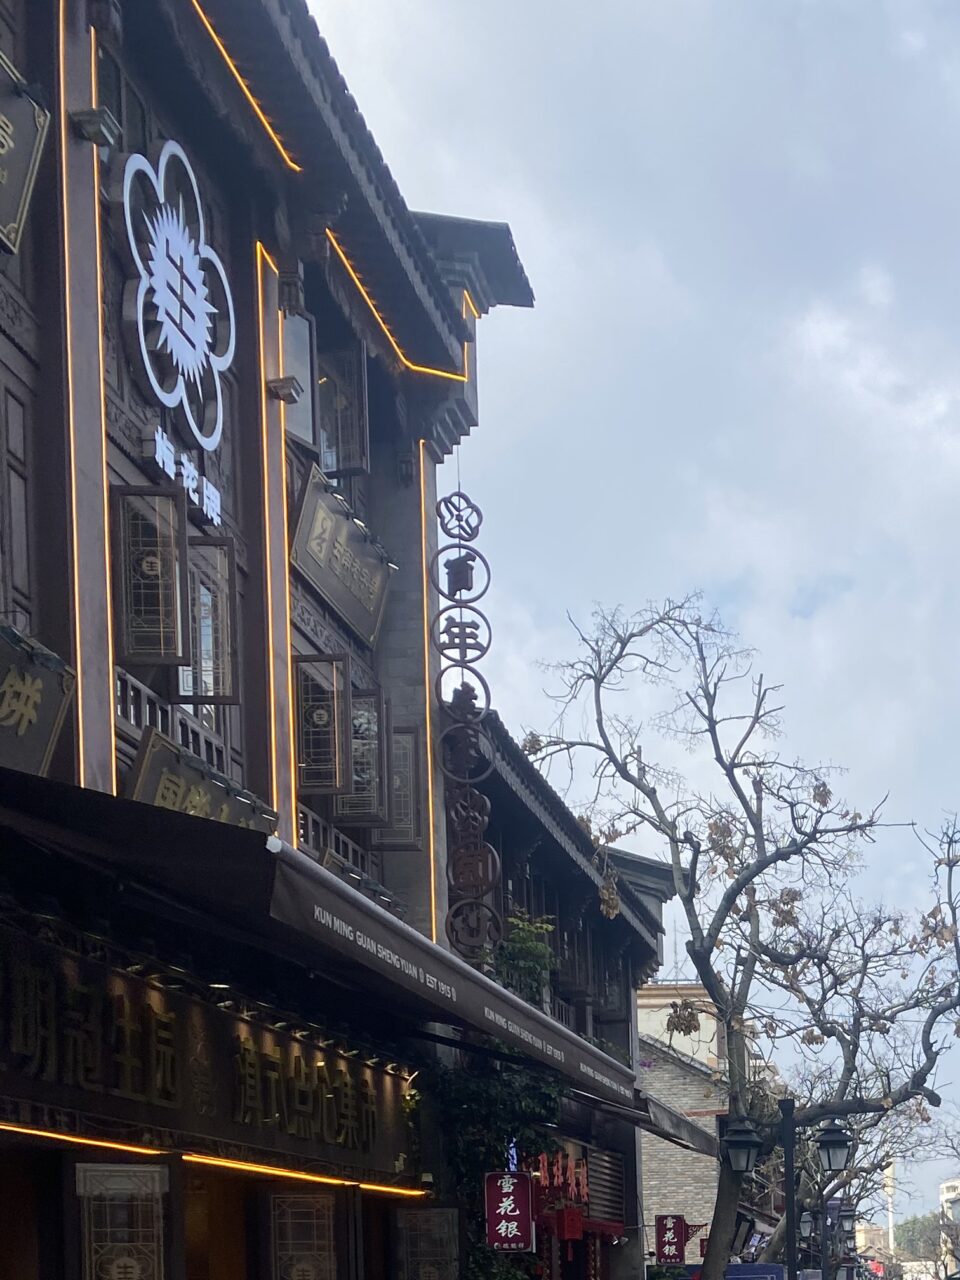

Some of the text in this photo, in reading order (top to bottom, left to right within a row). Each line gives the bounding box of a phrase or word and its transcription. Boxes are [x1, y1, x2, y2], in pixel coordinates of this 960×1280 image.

[314, 905, 332, 929] KUN
[333, 916, 354, 941] MING
[356, 930, 377, 956] GUAN
[425, 974, 438, 991] EST
[438, 981, 452, 999] 1915
[495, 1174, 521, 1238] 雪花银
[662, 1216, 678, 1256] 雪花银
